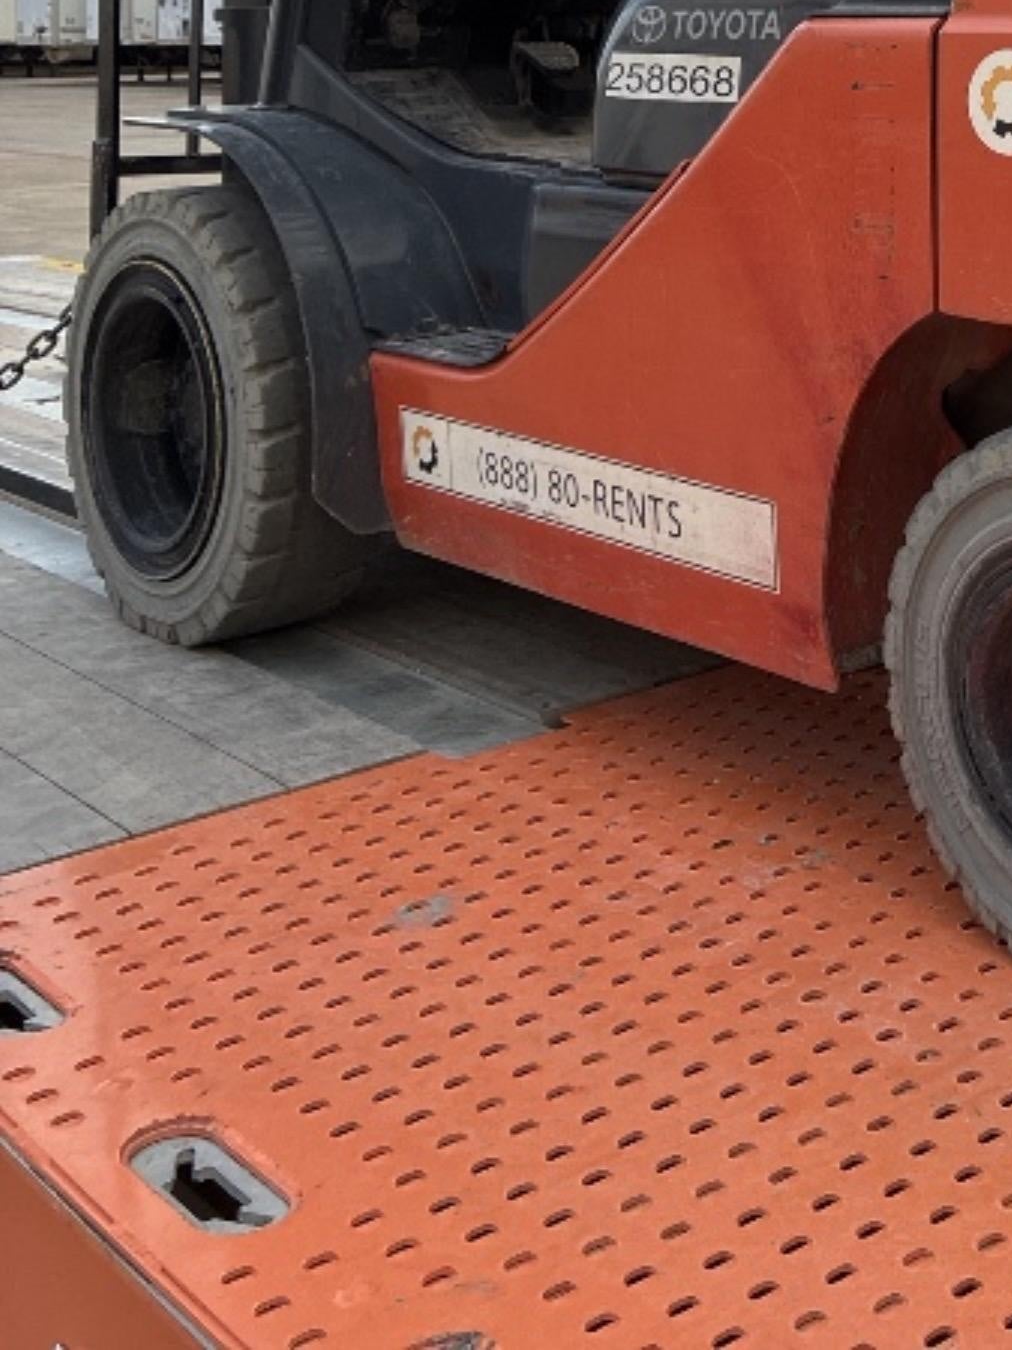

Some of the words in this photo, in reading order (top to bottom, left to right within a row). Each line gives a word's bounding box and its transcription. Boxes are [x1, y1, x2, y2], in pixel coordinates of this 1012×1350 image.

[672, 9, 781, 41] TOYOTA
[605, 62, 735, 98] 258668
[477, 446, 538, 502] (888)
[548, 469, 683, 539] 80-RENTS
